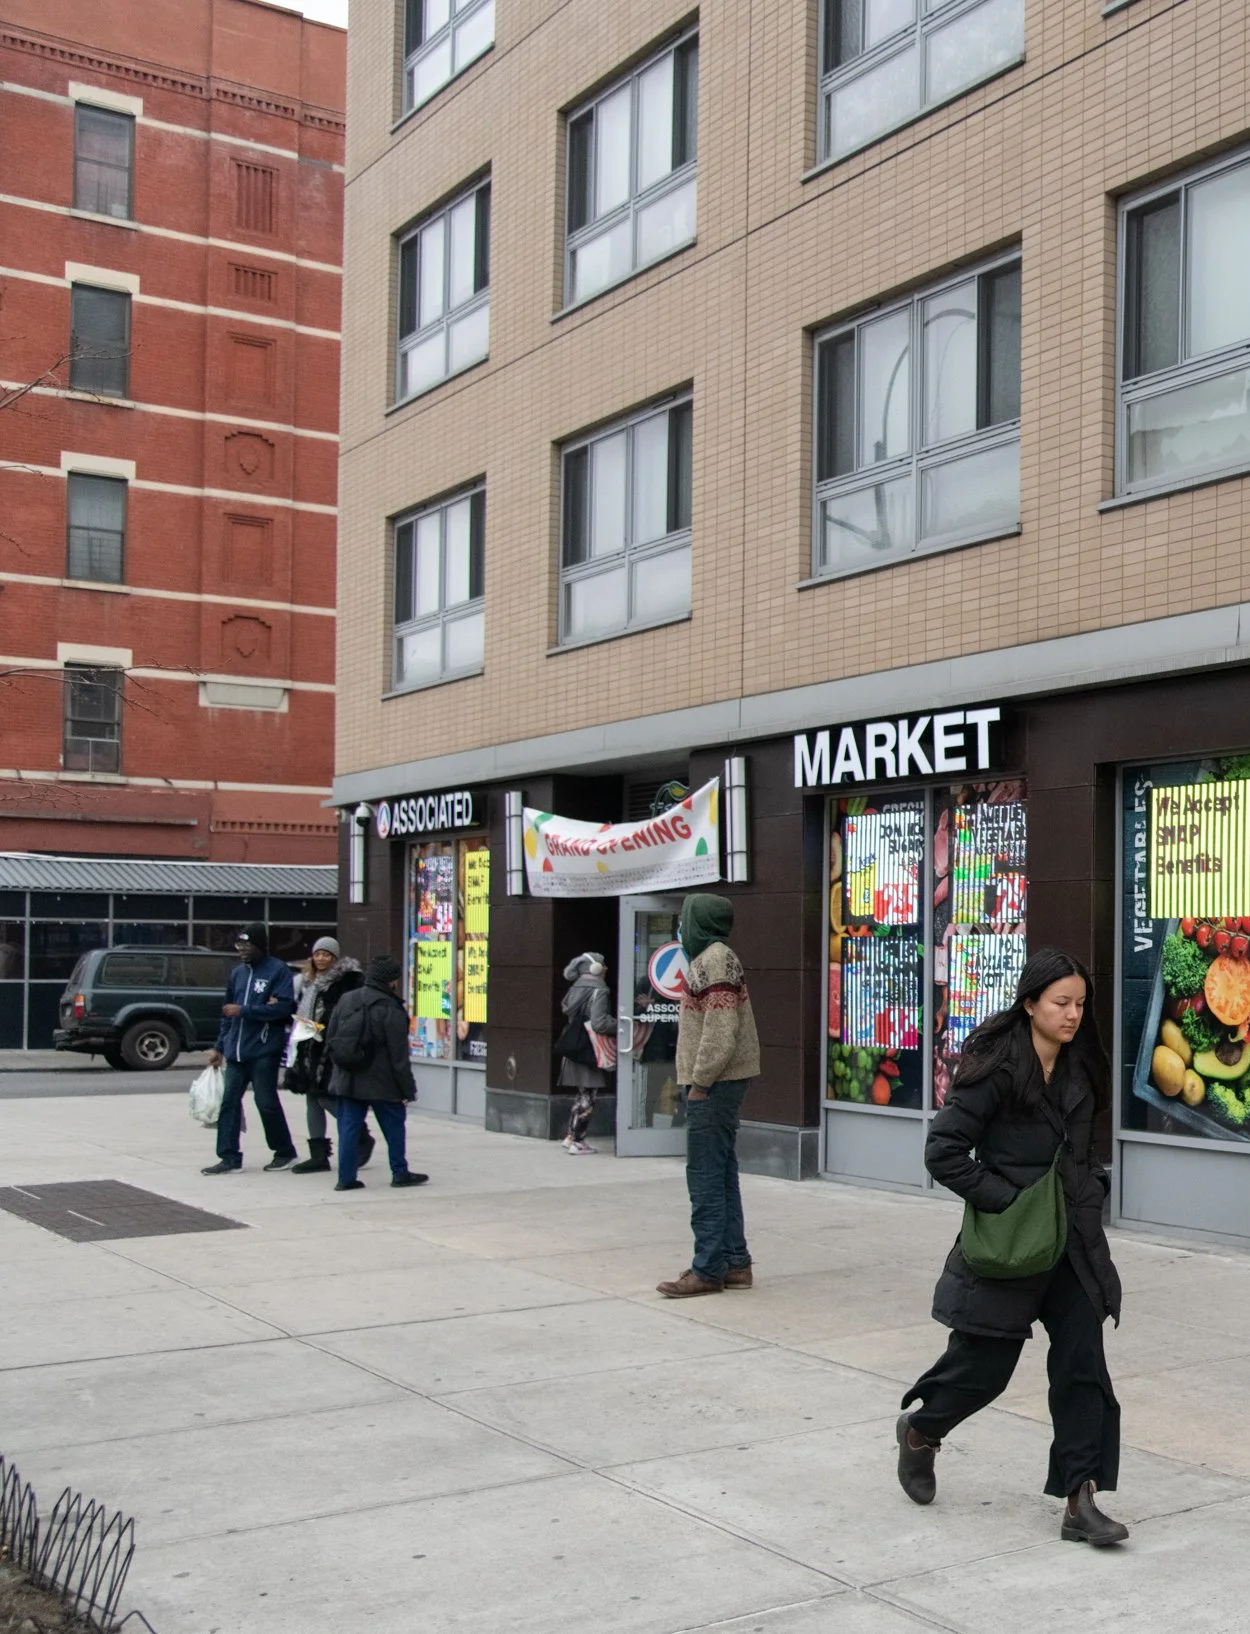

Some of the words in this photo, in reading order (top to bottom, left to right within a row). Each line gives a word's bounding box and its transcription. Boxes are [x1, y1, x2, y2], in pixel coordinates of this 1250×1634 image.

[794, 707, 1001, 788] MARKET
[391, 791, 473, 836] ASSOCIATED
[1156, 796, 1180, 817] We
[1183, 794, 1240, 816] Accept
[1156, 824, 1200, 847] SNAP
[1157, 853, 1222, 876] Benefits
[646, 1003, 681, 1013] ASSOC
